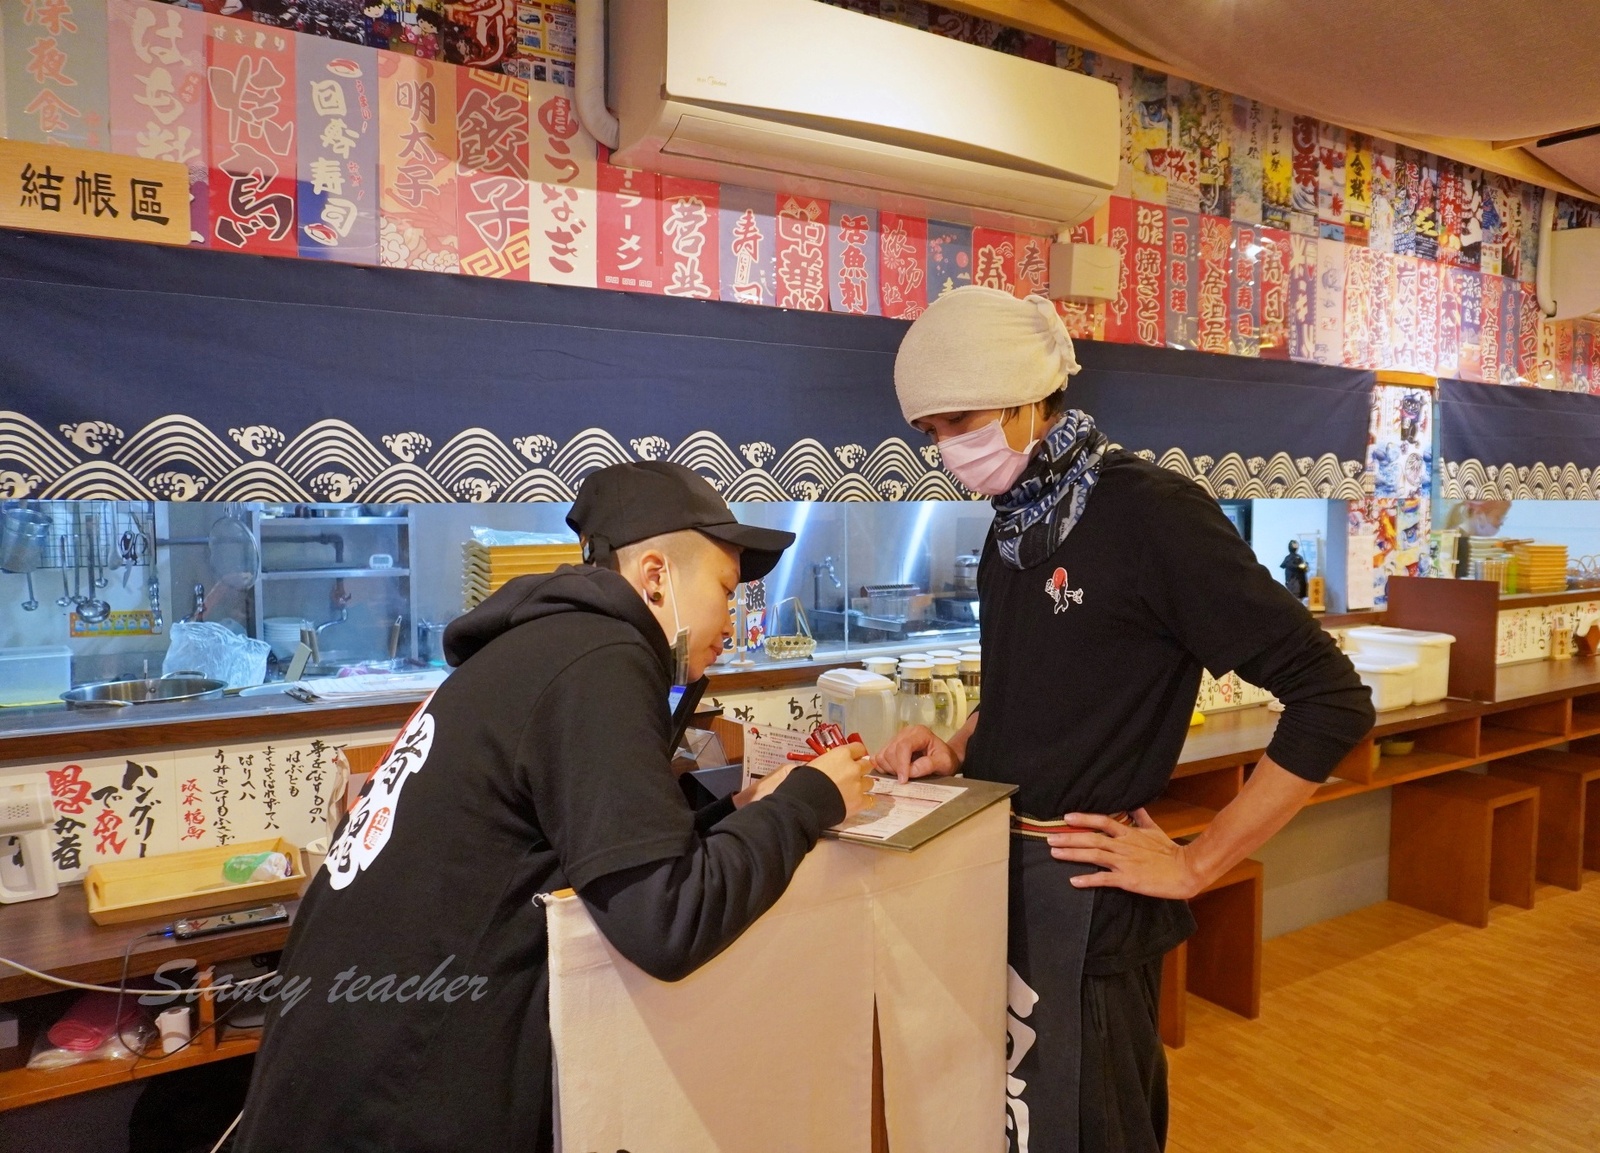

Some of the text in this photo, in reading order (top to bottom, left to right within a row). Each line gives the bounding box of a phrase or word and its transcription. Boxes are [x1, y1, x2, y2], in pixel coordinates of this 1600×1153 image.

[26, 0, 80, 147] 深夜食
[20, 162, 170, 226] 結帳區
[394, 80, 440, 208] 明太子
[838, 214, 869, 314] 活魚刺
[46, 764, 93, 870] 愚か者
[121, 759, 161, 858] ハングリー
